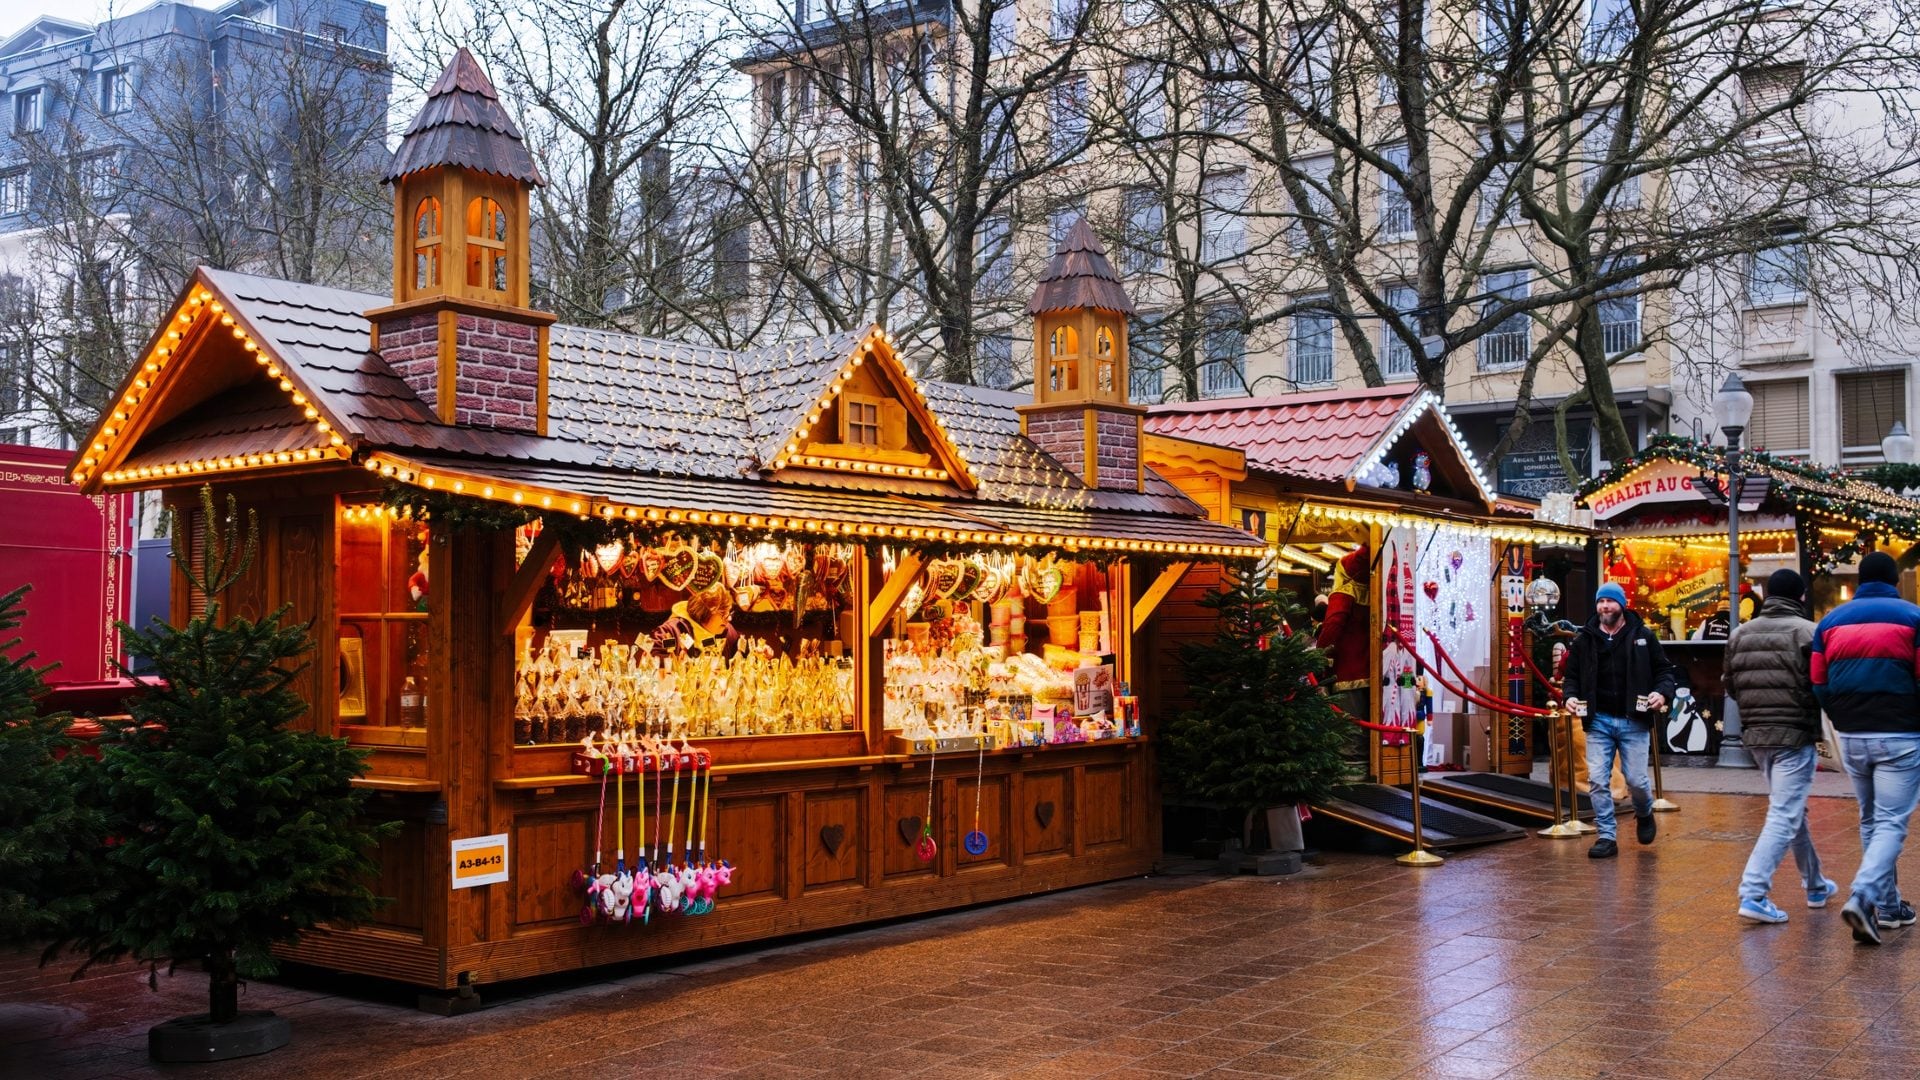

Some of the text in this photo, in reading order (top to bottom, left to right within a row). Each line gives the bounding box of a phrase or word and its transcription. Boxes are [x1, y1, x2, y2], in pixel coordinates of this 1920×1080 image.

[1594, 480, 1651, 515] CHALET
[1656, 476, 1677, 492] AU
[459, 855, 501, 869] A3-B4-13
